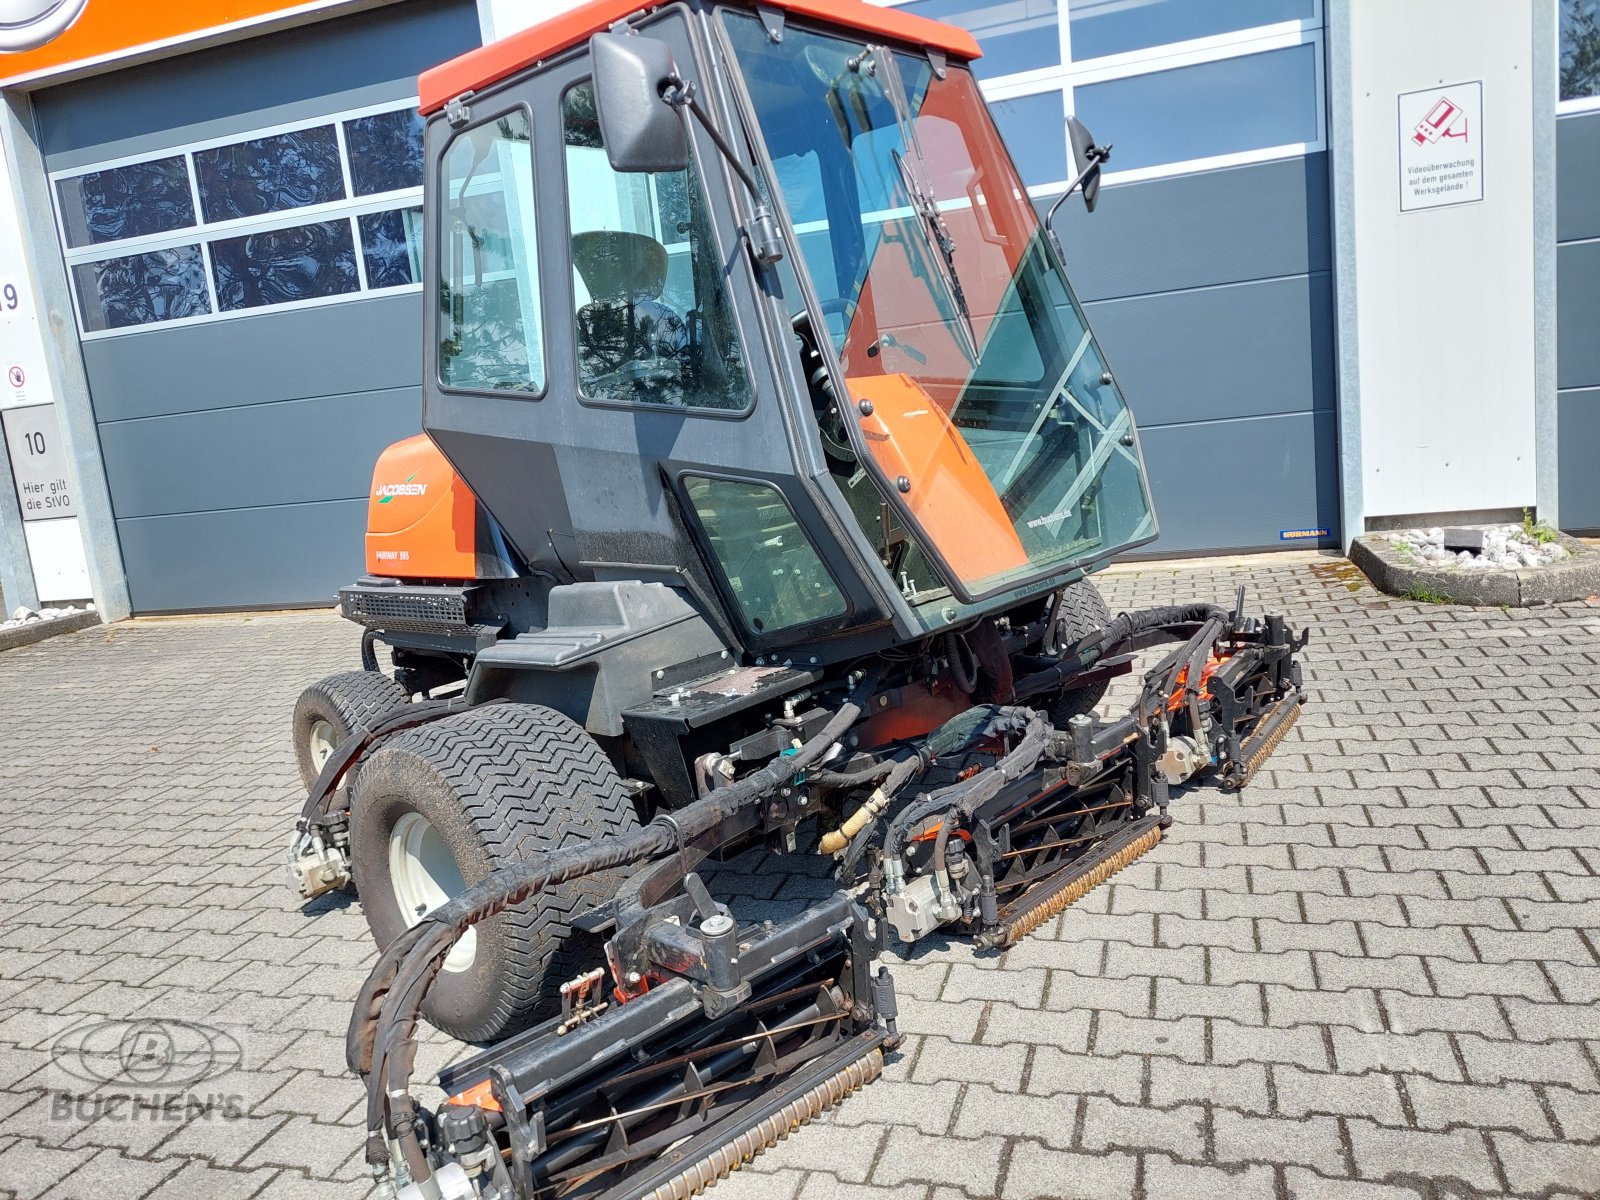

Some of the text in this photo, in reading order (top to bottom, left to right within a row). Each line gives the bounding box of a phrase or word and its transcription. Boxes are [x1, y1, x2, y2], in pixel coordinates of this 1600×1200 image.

[1407, 159, 1475, 175] Videoüberwachung
[1408, 169, 1474, 186] auf dem gesamten
[1414, 183, 1464, 196] Werksgelände
[0, 283, 18, 311] 9
[24, 431, 46, 456] 10
[22, 478, 67, 495] Hier gilt
[375, 484, 428, 496] JACOBSEN
[26, 494, 70, 510] die StVO
